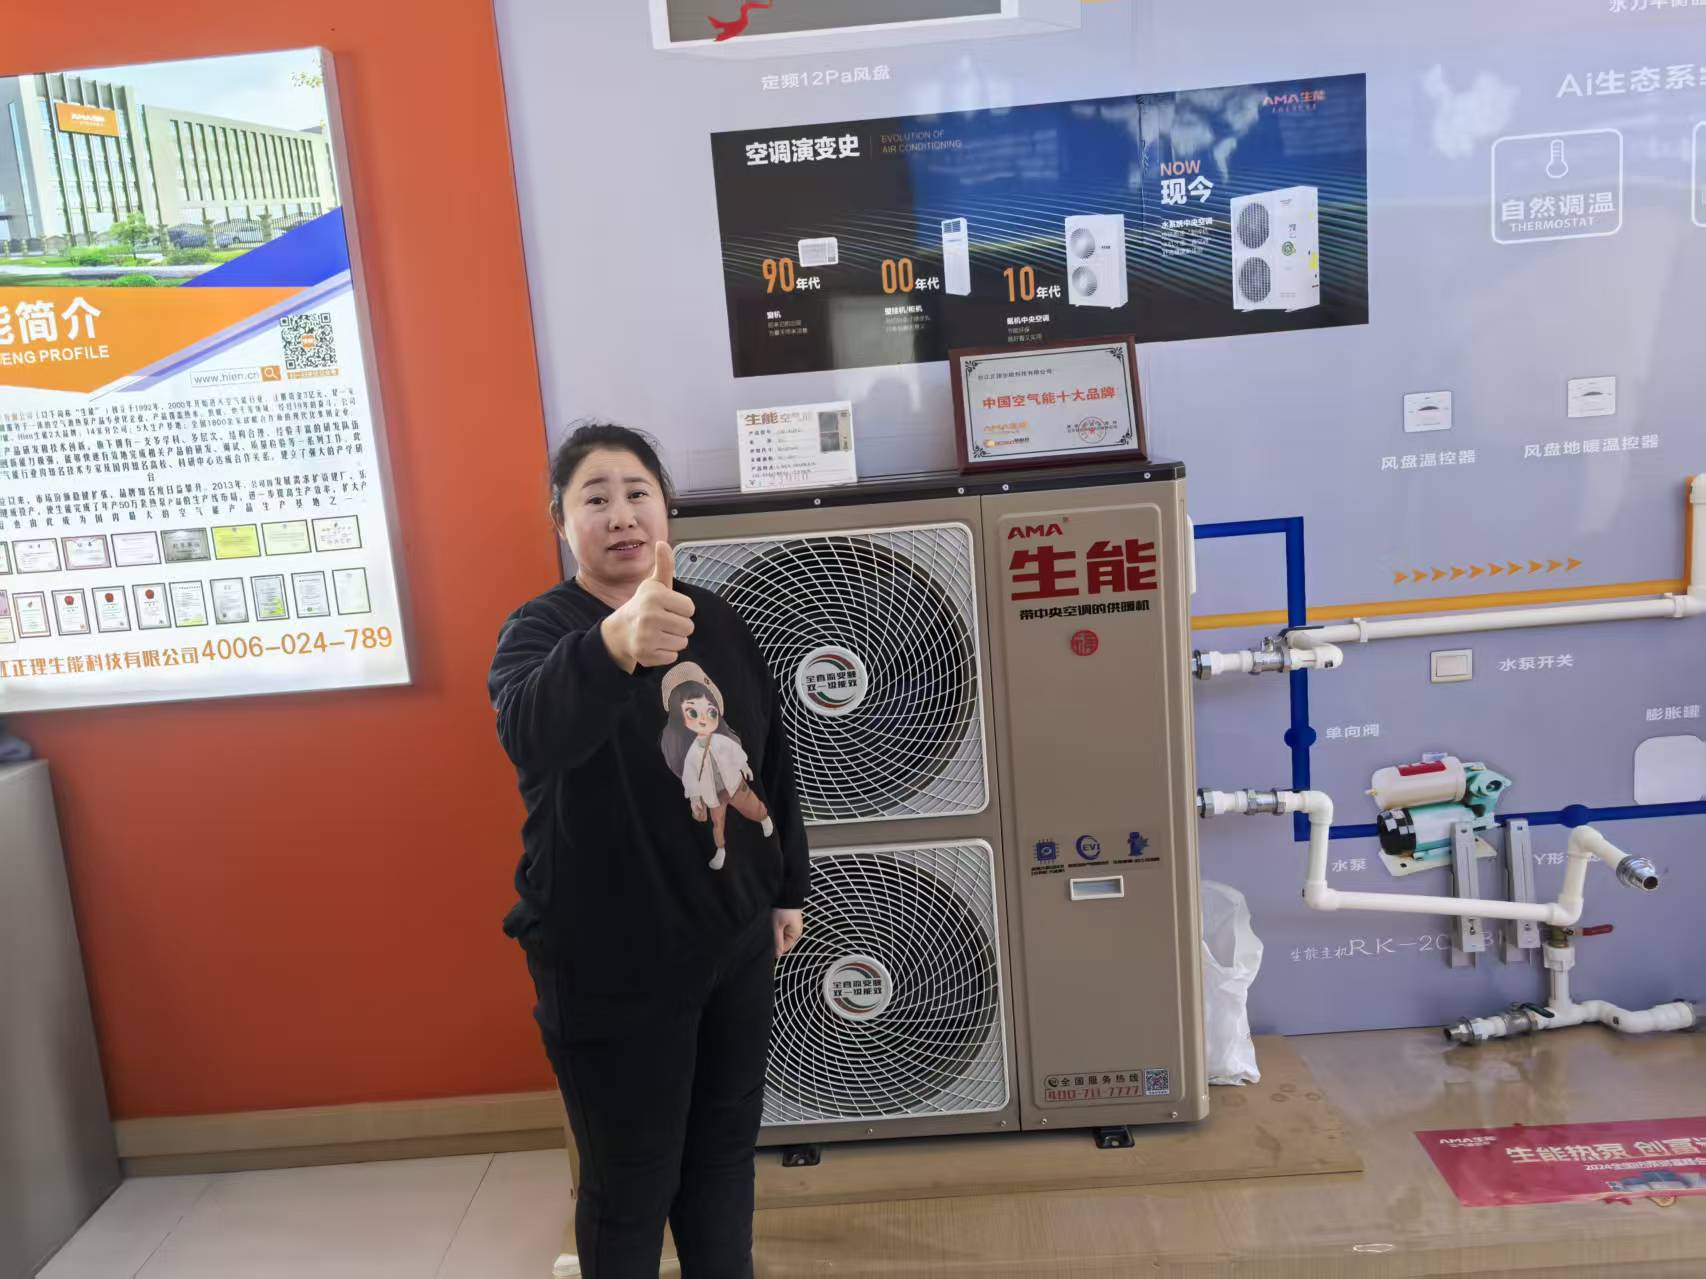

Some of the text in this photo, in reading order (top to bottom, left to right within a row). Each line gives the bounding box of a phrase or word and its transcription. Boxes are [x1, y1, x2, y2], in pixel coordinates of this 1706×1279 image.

[761, 65, 891, 90] 定频12Pa风盘
[1555, 64, 1706, 98] Ai生态系
[881, 130, 945, 143] EVOLUTION OF
[882, 140, 962, 153] AIR CONDITIONING
[745, 133, 861, 166] 空调演变史
[1160, 160, 1201, 177] NOW
[1160, 176, 1214, 205] 现今
[1502, 192, 1616, 222] 自然调温
[1511, 216, 1594, 233] THERMOSTAT
[0, 344, 110, 366] ENG PROFILE
[194, 370, 259, 384] www.hien.cn
[982, 386, 1116, 409] 中国空气能十大品牌
[744, 411, 778, 426] 生能
[1524, 433, 1660, 459] 风盘地暖温控器
[1381, 449, 1476, 471] 风盘温控器
[1007, 523, 1063, 540] AMA
[1009, 538, 1158, 601] 生能
[1019, 599, 1150, 621] 带中央空调的供暖机
[202, 626, 393, 661] 4006-024-789
[1498, 654, 1575, 672] 水泵开关
[1646, 705, 1702, 721] 膨胀罐
[1325, 724, 1380, 740] 单向阀
[1332, 858, 1368, 872] 水泵
[1060, 1073, 1139, 1087] 全国服务热线
[1505, 1143, 1629, 1163] 生能热泵
